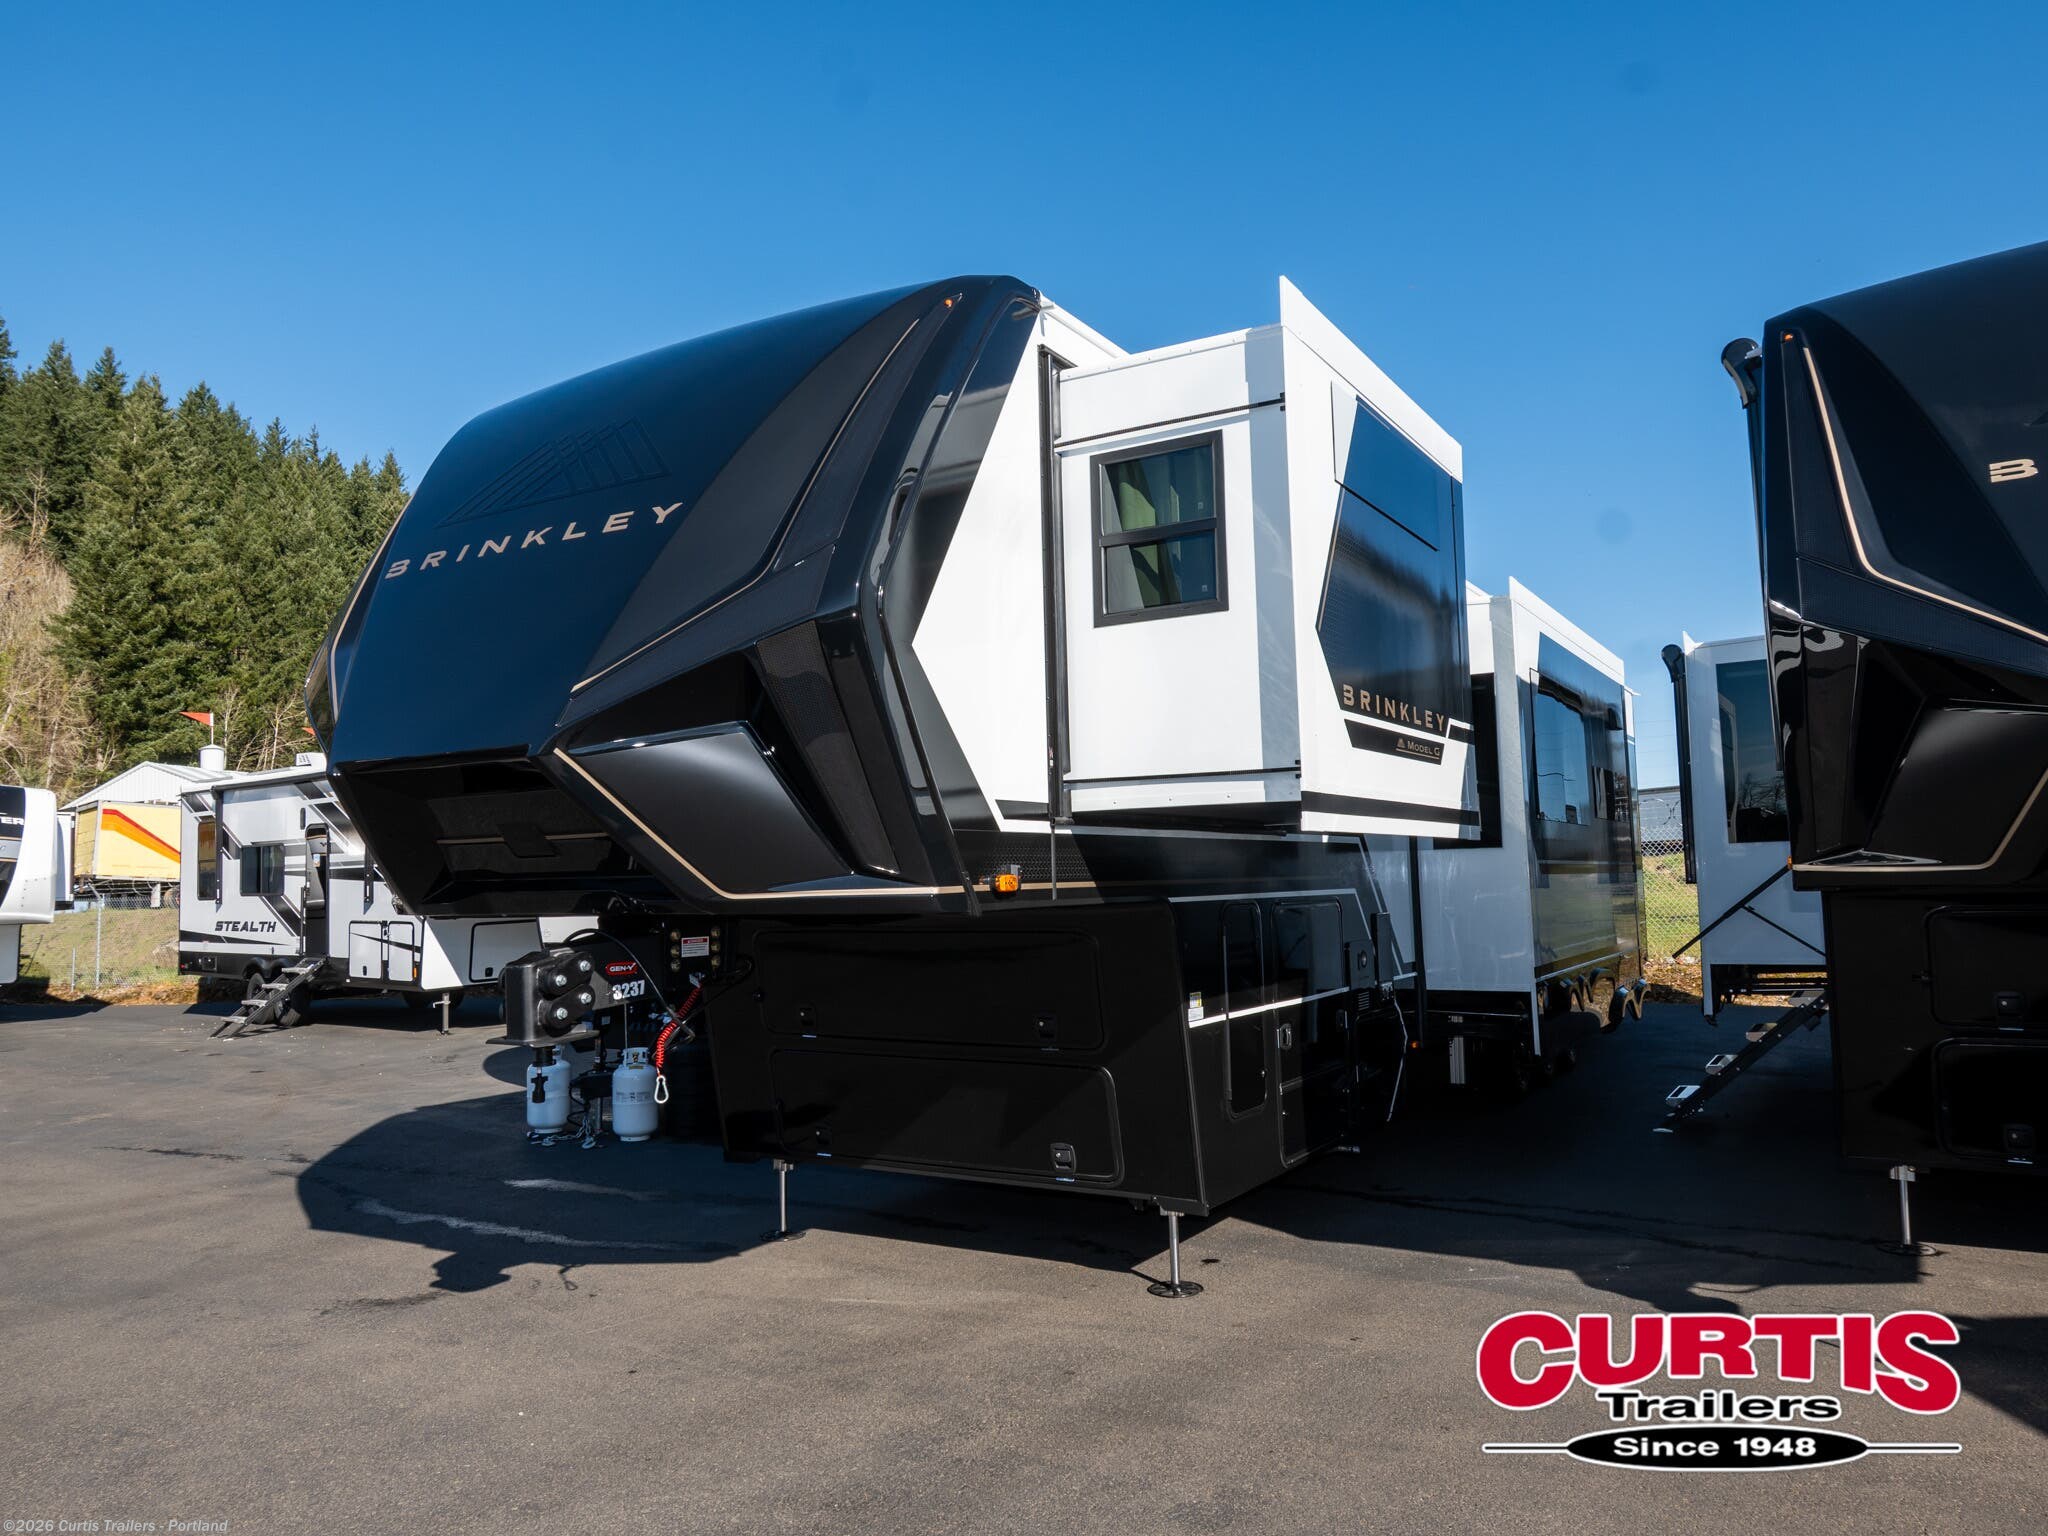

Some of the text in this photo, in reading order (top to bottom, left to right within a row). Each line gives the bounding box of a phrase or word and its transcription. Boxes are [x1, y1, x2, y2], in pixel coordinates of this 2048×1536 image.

[385, 502, 683, 579] BRINKLEY
[1342, 684, 1446, 731] BRINKLEY
[215, 921, 276, 932] STEALTH
[609, 962, 637, 972] GEN-Y
[612, 980, 645, 1000] 3237
